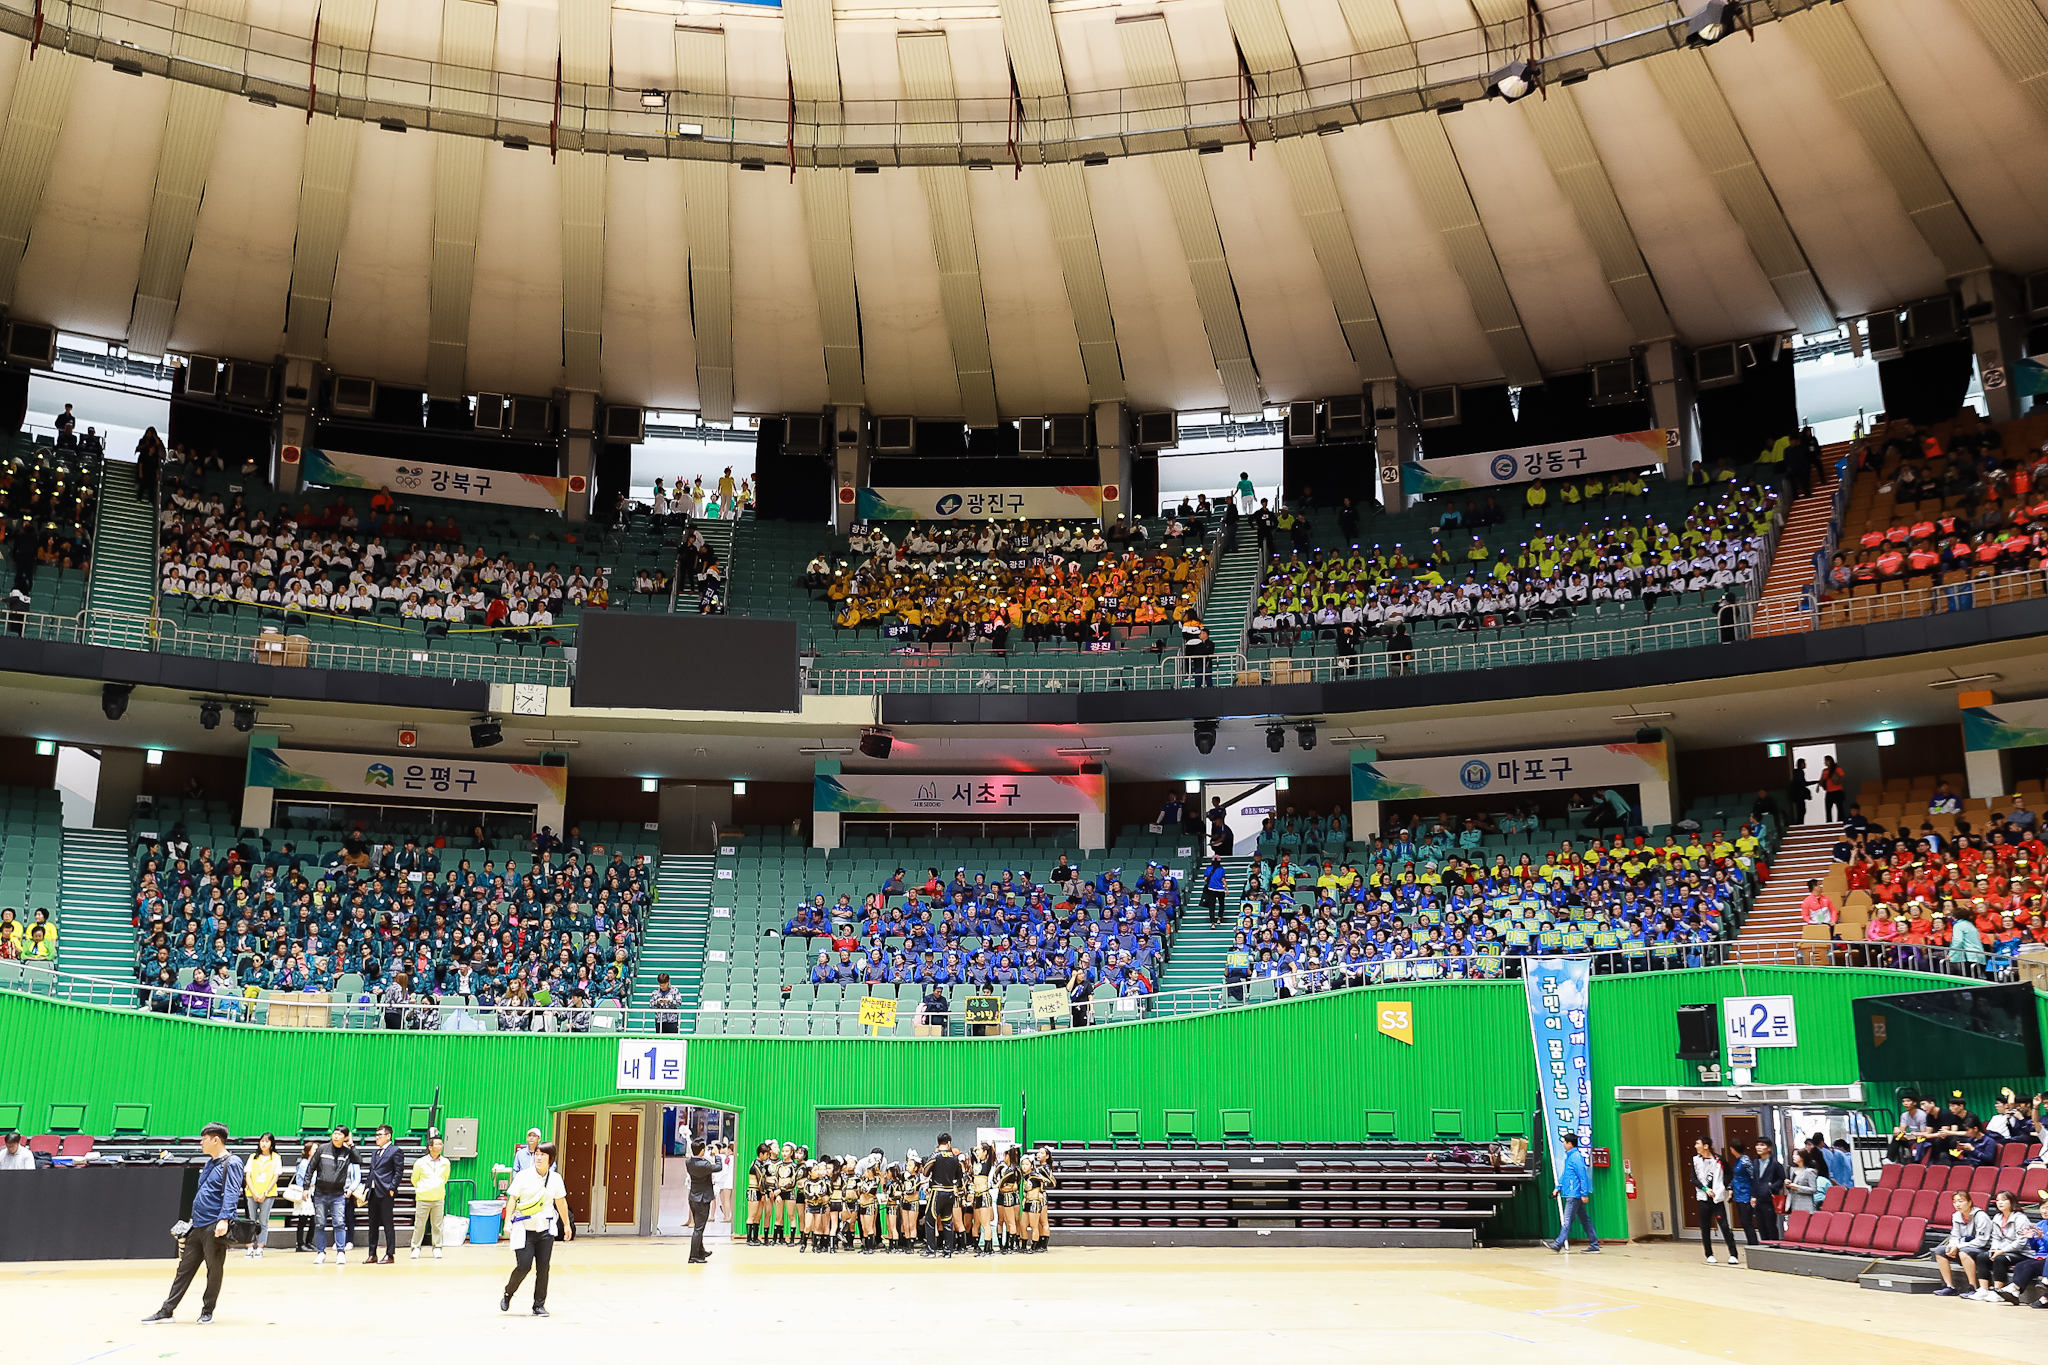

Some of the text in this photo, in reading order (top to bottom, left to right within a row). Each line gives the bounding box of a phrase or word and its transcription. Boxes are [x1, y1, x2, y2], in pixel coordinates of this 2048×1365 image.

[1987, 371, 2001, 385] 25
[1523, 448, 1588, 475] 강동구
[430, 469, 492, 496] 강북구
[1382, 469, 1397, 480] 24
[966, 493, 1025, 514] 광진구
[851, 524, 868, 535] 광진
[1009, 560, 1026, 569] 광진
[1159, 595, 1177, 606] 광진
[1090, 642, 1112, 651] 광진
[403, 765, 478, 793] 은평구
[1497, 756, 1573, 785] 마포구
[951, 782, 1021, 806] 서초구
[1505, 929, 1529, 945] 마포
[1540, 930, 1563, 947] 마포
[1562, 931, 1585, 948] 마포
[1594, 932, 1617, 947] 마포
[1227, 953, 1249, 967] 마포
[970, 998, 990, 1008] 서초
[1038, 1003, 1057, 1014] 서초
[1543, 976, 1561, 1030] 구민이
[864, 1010, 885, 1024] 서초
[1381, 1009, 1409, 1030] S3
[1731, 1003, 1789, 1039] 내2문
[1568, 1008, 1586, 1046] 함께
[624, 1046, 680, 1080] 내1문
[1548, 1039, 1568, 1099] 꿈꾸는
